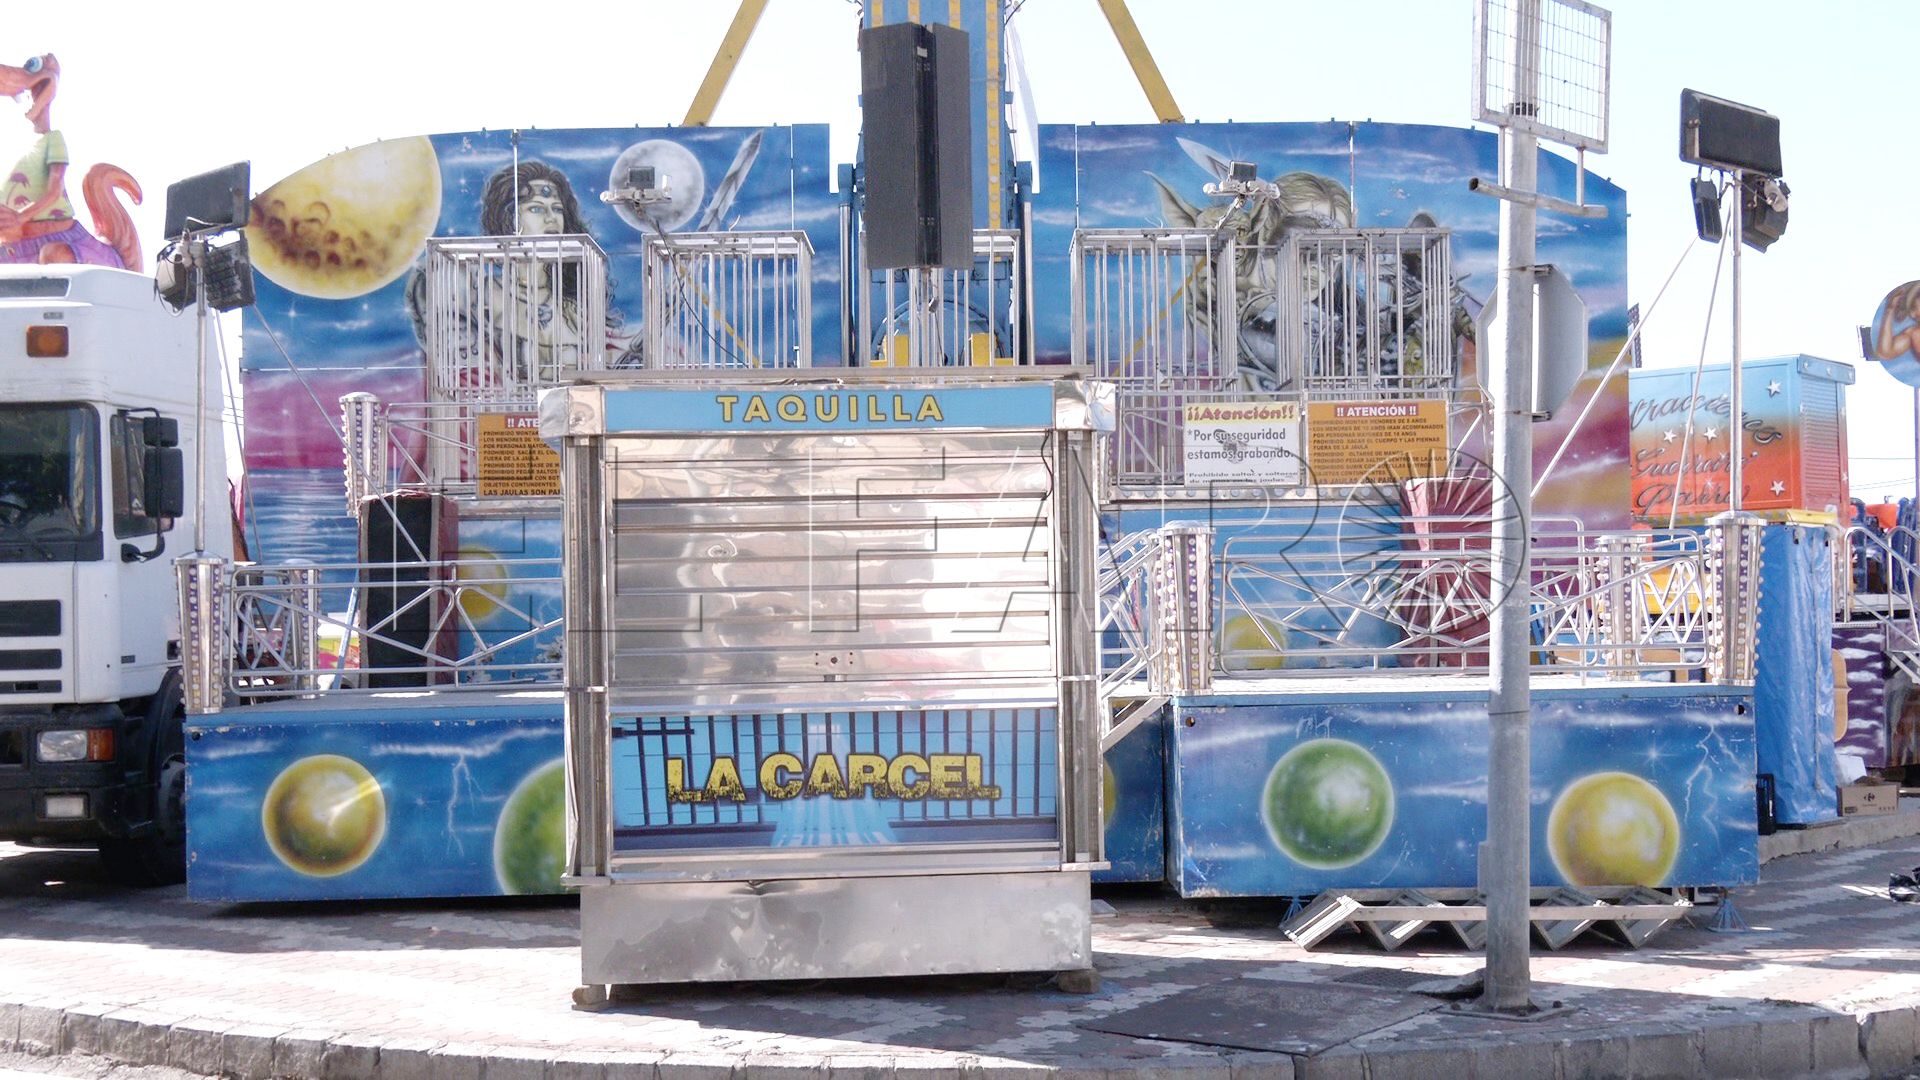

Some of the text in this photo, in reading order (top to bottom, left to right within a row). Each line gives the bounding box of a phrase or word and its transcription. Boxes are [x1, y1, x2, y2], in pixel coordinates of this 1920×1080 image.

[716, 395, 944, 422] TAQUILLA
[1187, 405, 1294, 420] ¡¡Atención!!
[1346, 405, 1406, 416] ATENCIÓN
[518, 417, 540, 428] ATE
[1231, 427, 1286, 443] seguridad
[1187, 449, 1234, 460] estamos
[665, 752, 1002, 803] LA CARCEL
